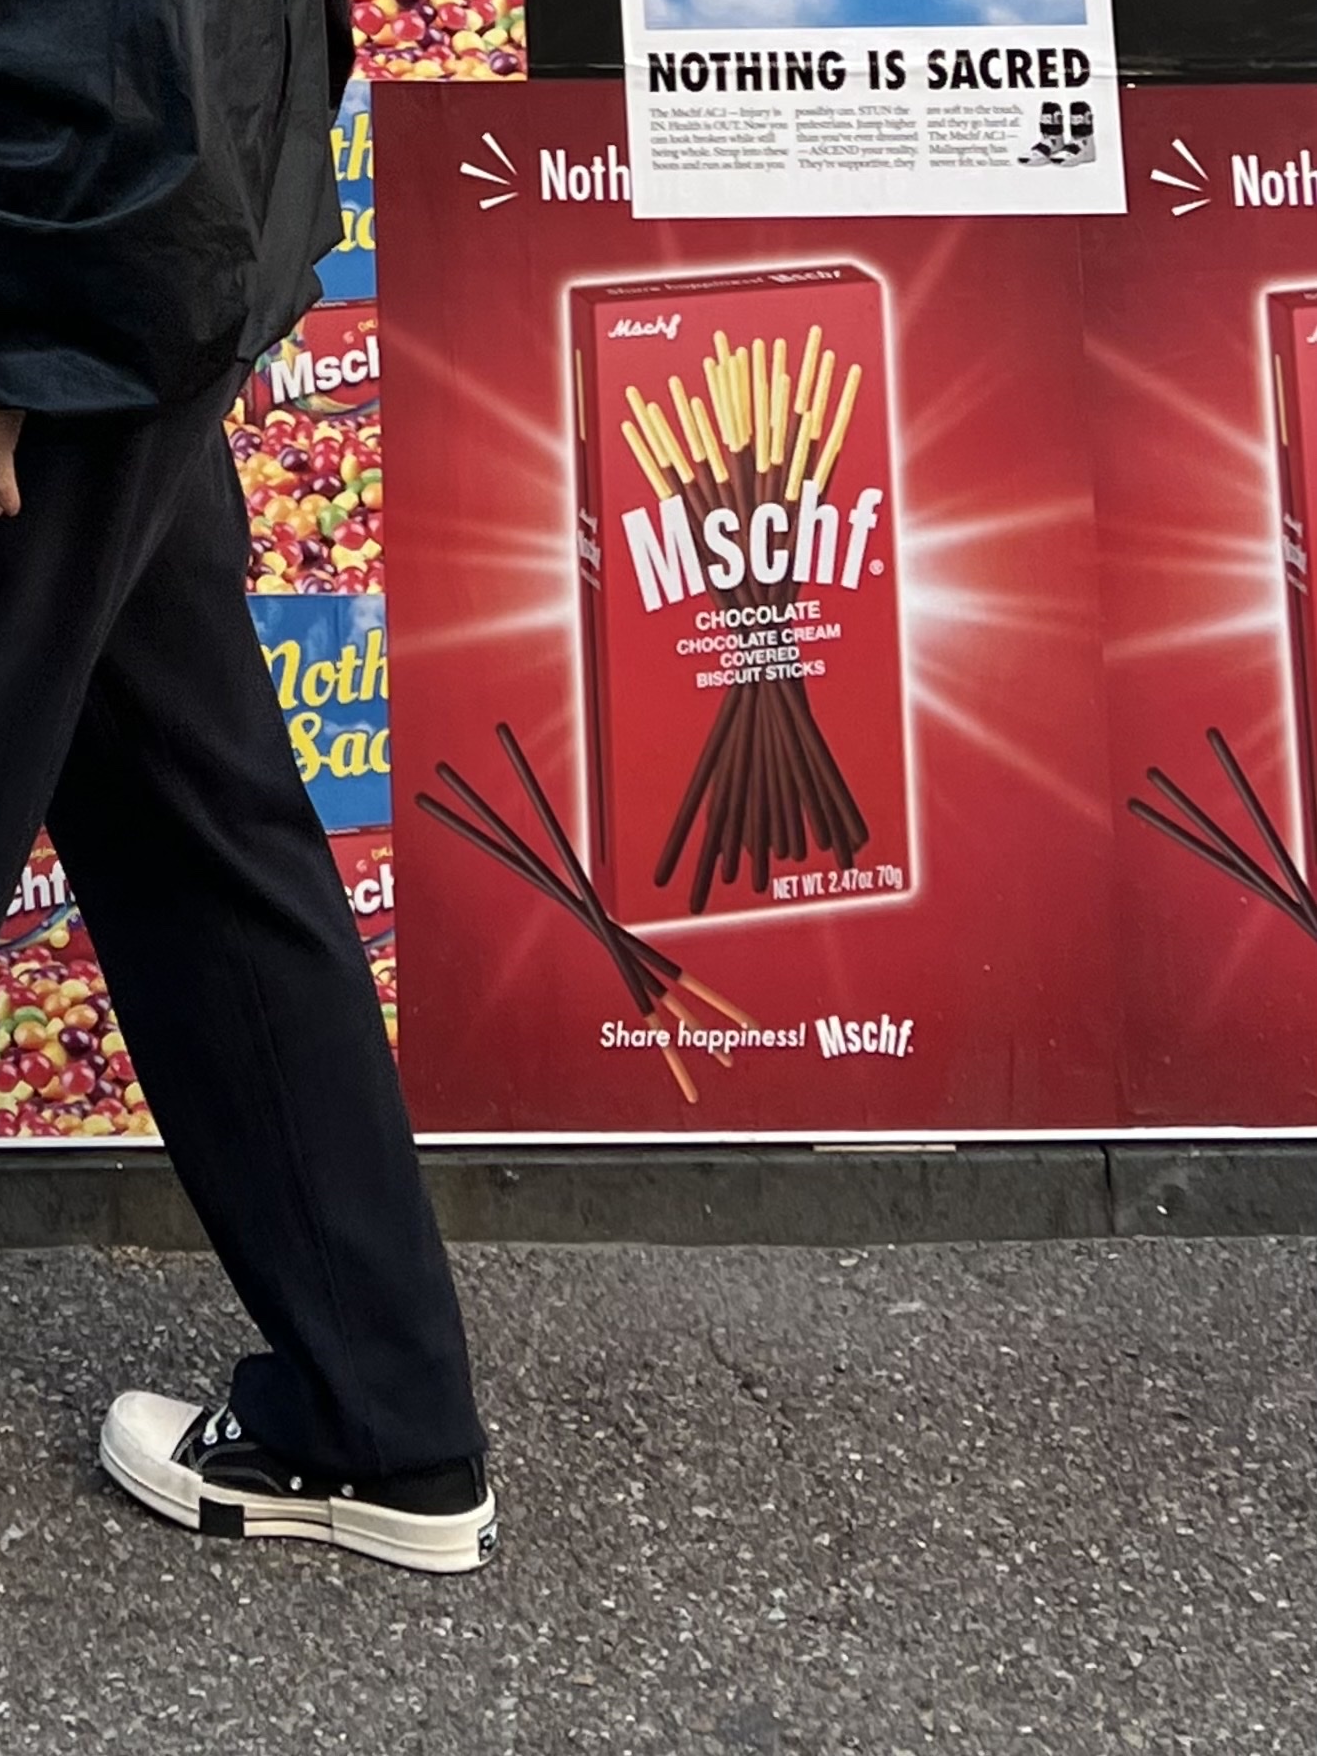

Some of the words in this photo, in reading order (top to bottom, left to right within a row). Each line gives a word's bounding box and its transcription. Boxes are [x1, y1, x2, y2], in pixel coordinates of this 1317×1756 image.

[647, 50, 846, 92] NOTHING
[868, 49, 906, 90] IS
[928, 47, 1090, 90] SACRED
[540, 144, 631, 201] Noth
[1231, 150, 1317, 206] Noth
[608, 313, 681, 340] Mschf
[695, 600, 821, 631] CHOCOLATE
[676, 630, 779, 656] CHOCOLATE
[783, 624, 841, 645] CREAM
[720, 646, 800, 668] COVERED
[696, 665, 762, 688] BISCUIT
[765, 660, 825, 682] STICKS
[773, 875, 798, 900] NET
[802, 873, 824, 896] WT.
[828, 869, 873, 894] 2.47oz
[877, 865, 903, 890] 70g
[600, 1020, 670, 1048] Share
[678, 1021, 806, 1054] happiness!
